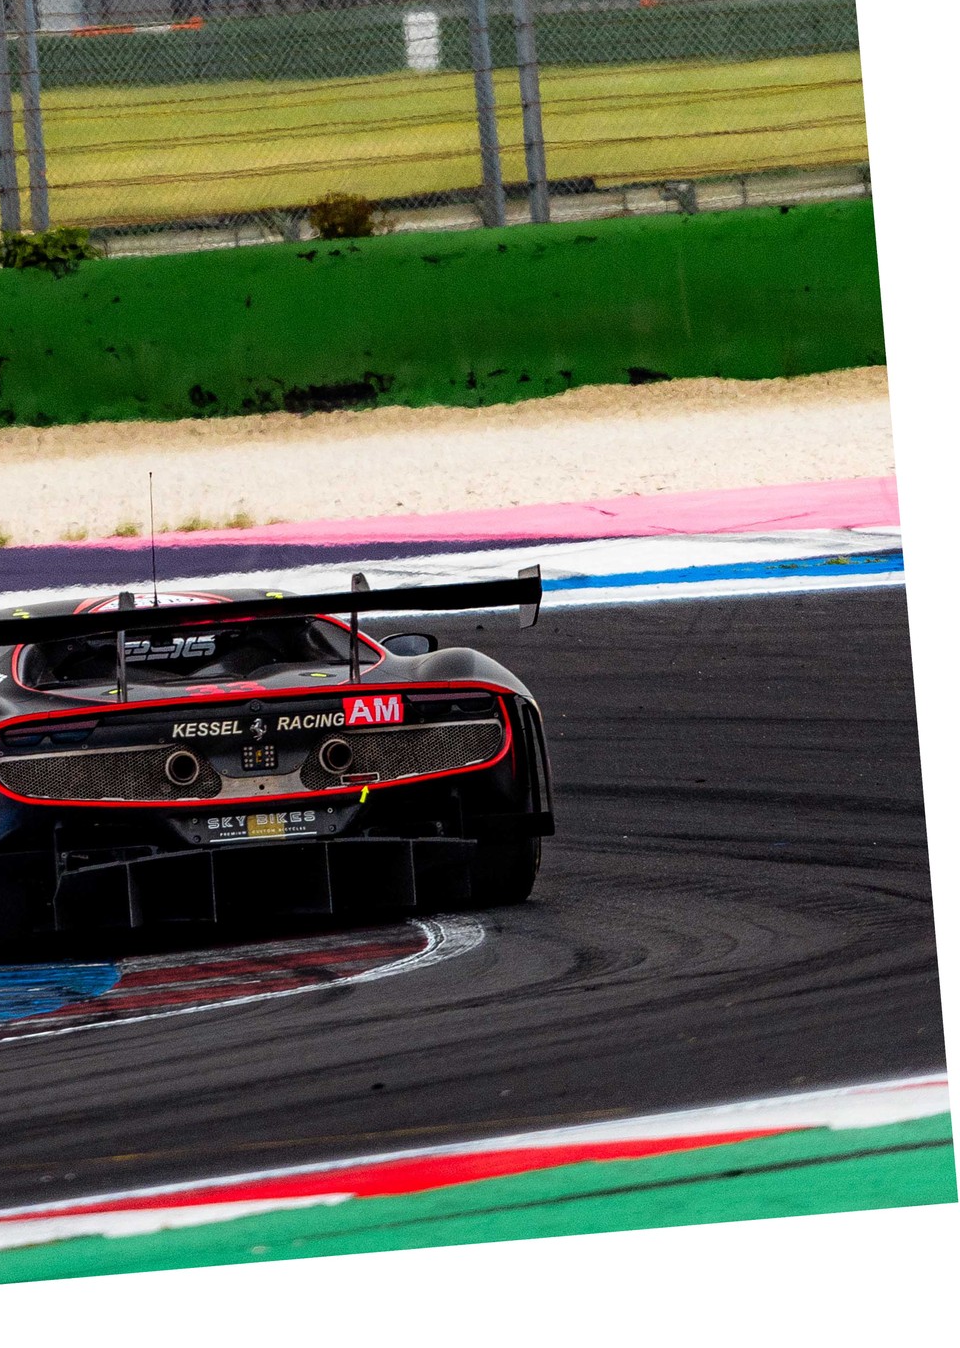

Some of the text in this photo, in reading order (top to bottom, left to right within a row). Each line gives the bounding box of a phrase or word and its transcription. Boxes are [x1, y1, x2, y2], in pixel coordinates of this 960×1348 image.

[348, 696, 399, 724] AM
[172, 712, 345, 738] KESSEL RACING
[207, 810, 316, 829] SKY BIKES
